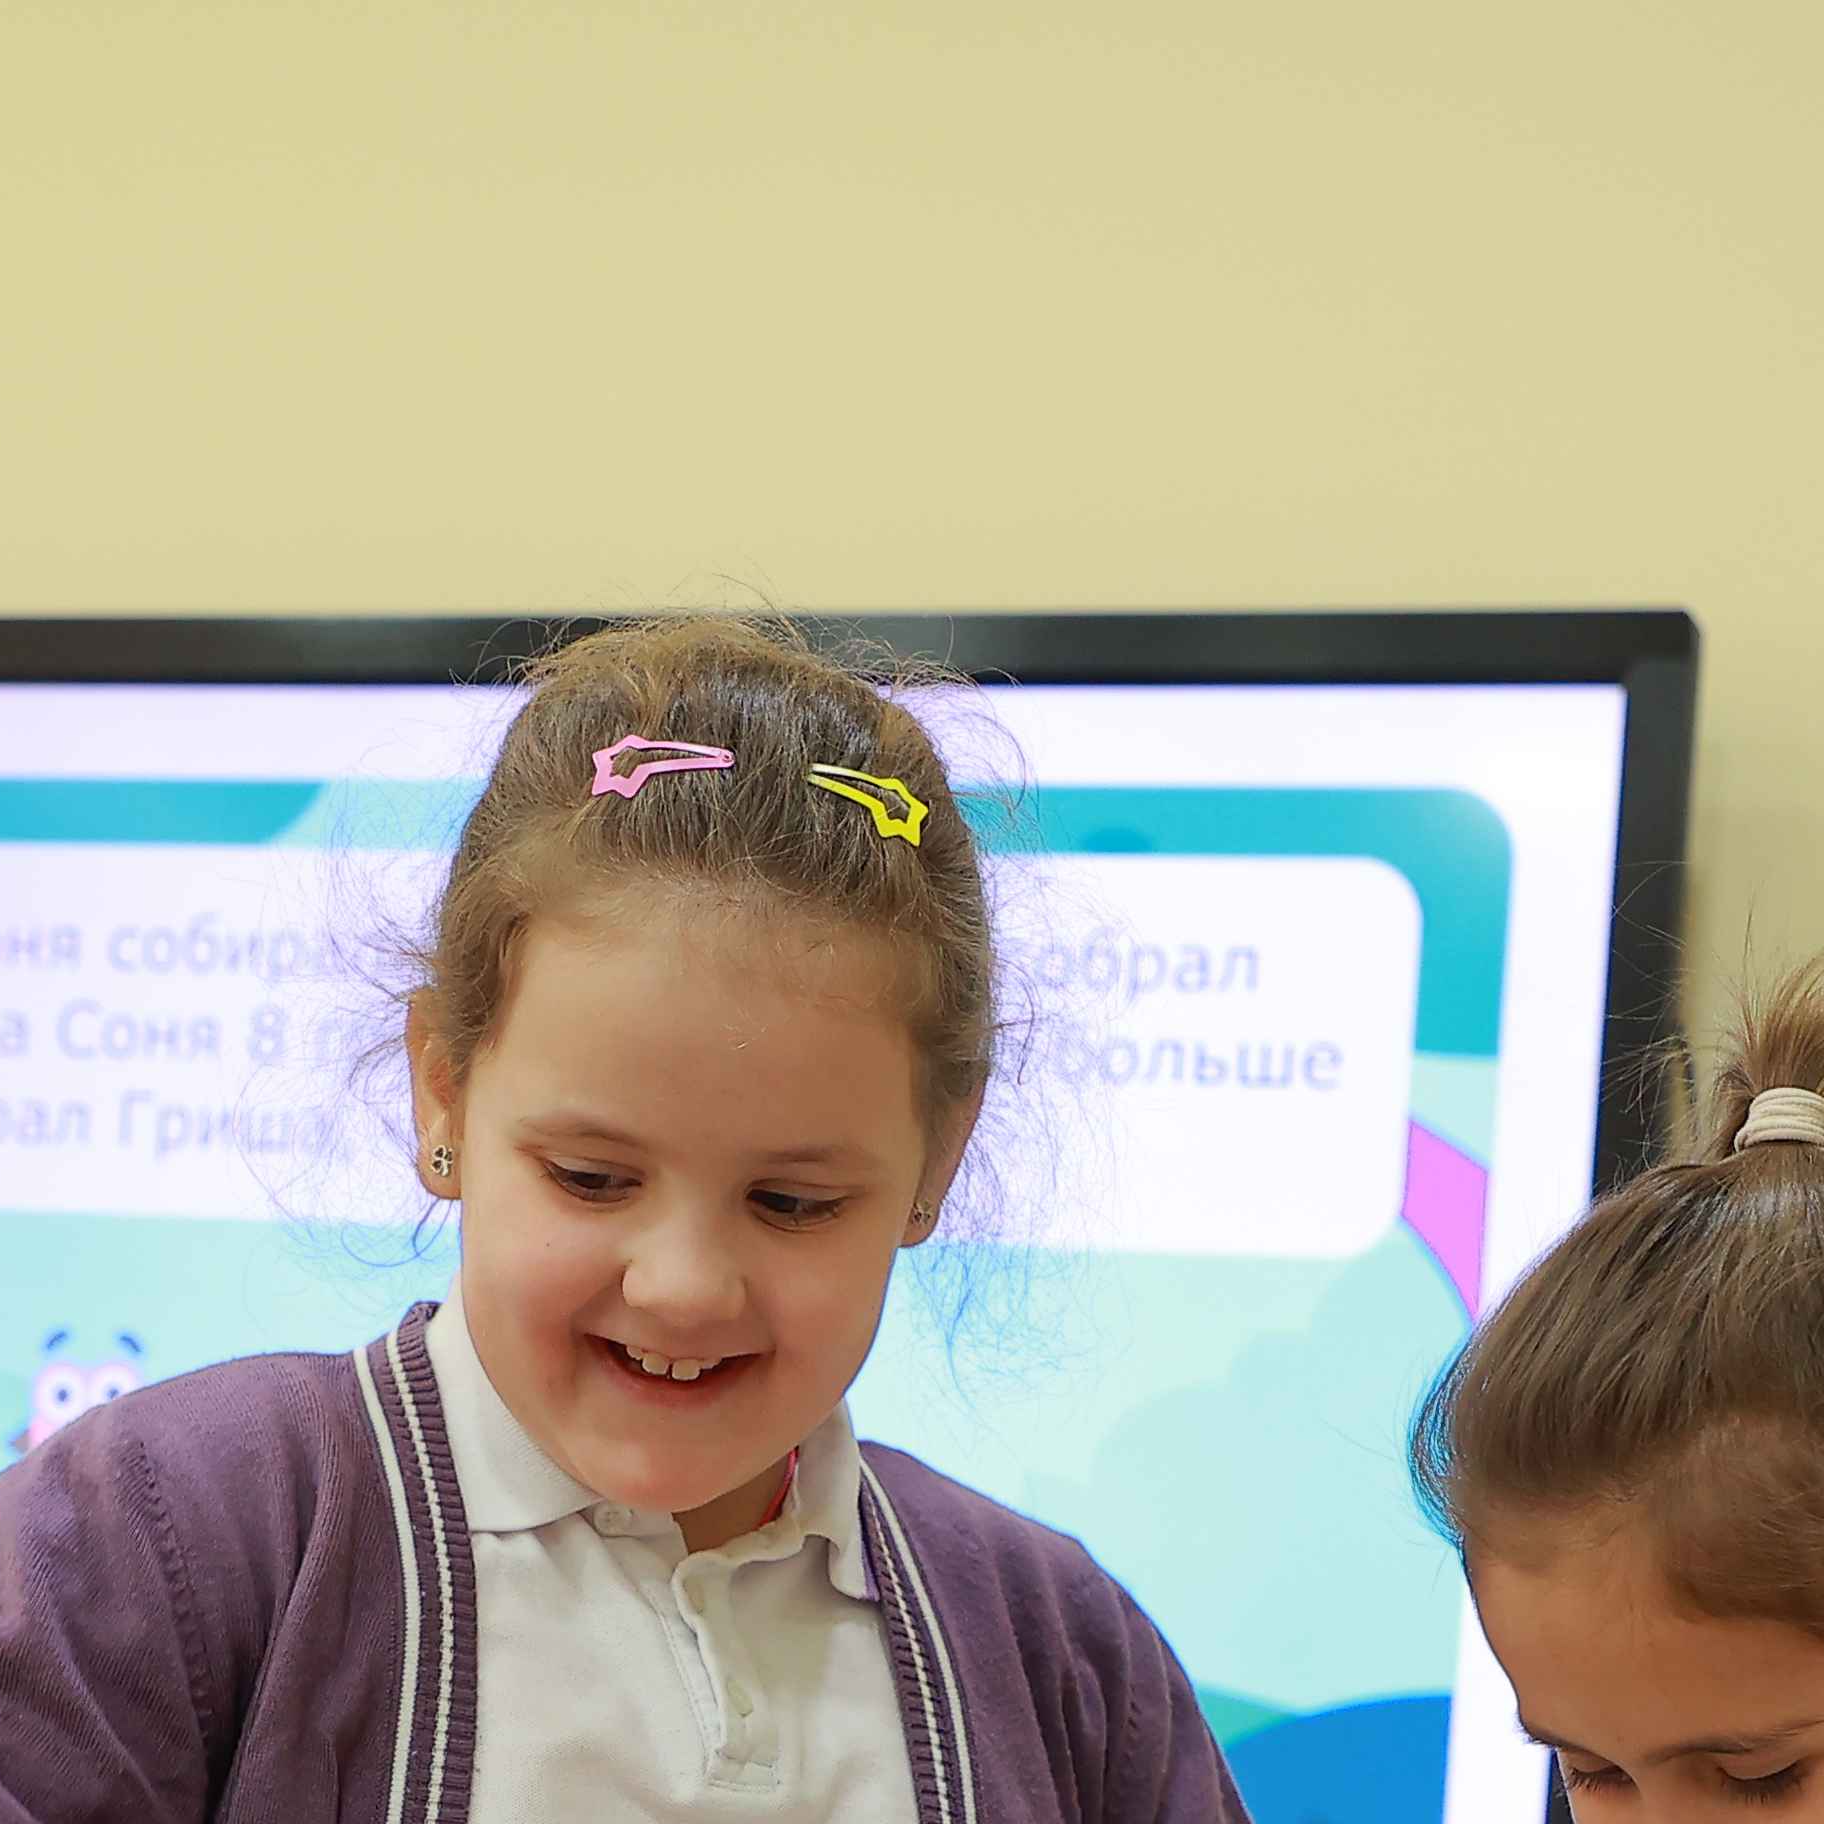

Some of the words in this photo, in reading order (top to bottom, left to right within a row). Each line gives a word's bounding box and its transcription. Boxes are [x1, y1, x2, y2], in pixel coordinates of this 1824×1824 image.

[1032, 926, 1259, 1006] обрал
[56, 998, 221, 1060] Соня
[248, 1003, 288, 1060] 8
